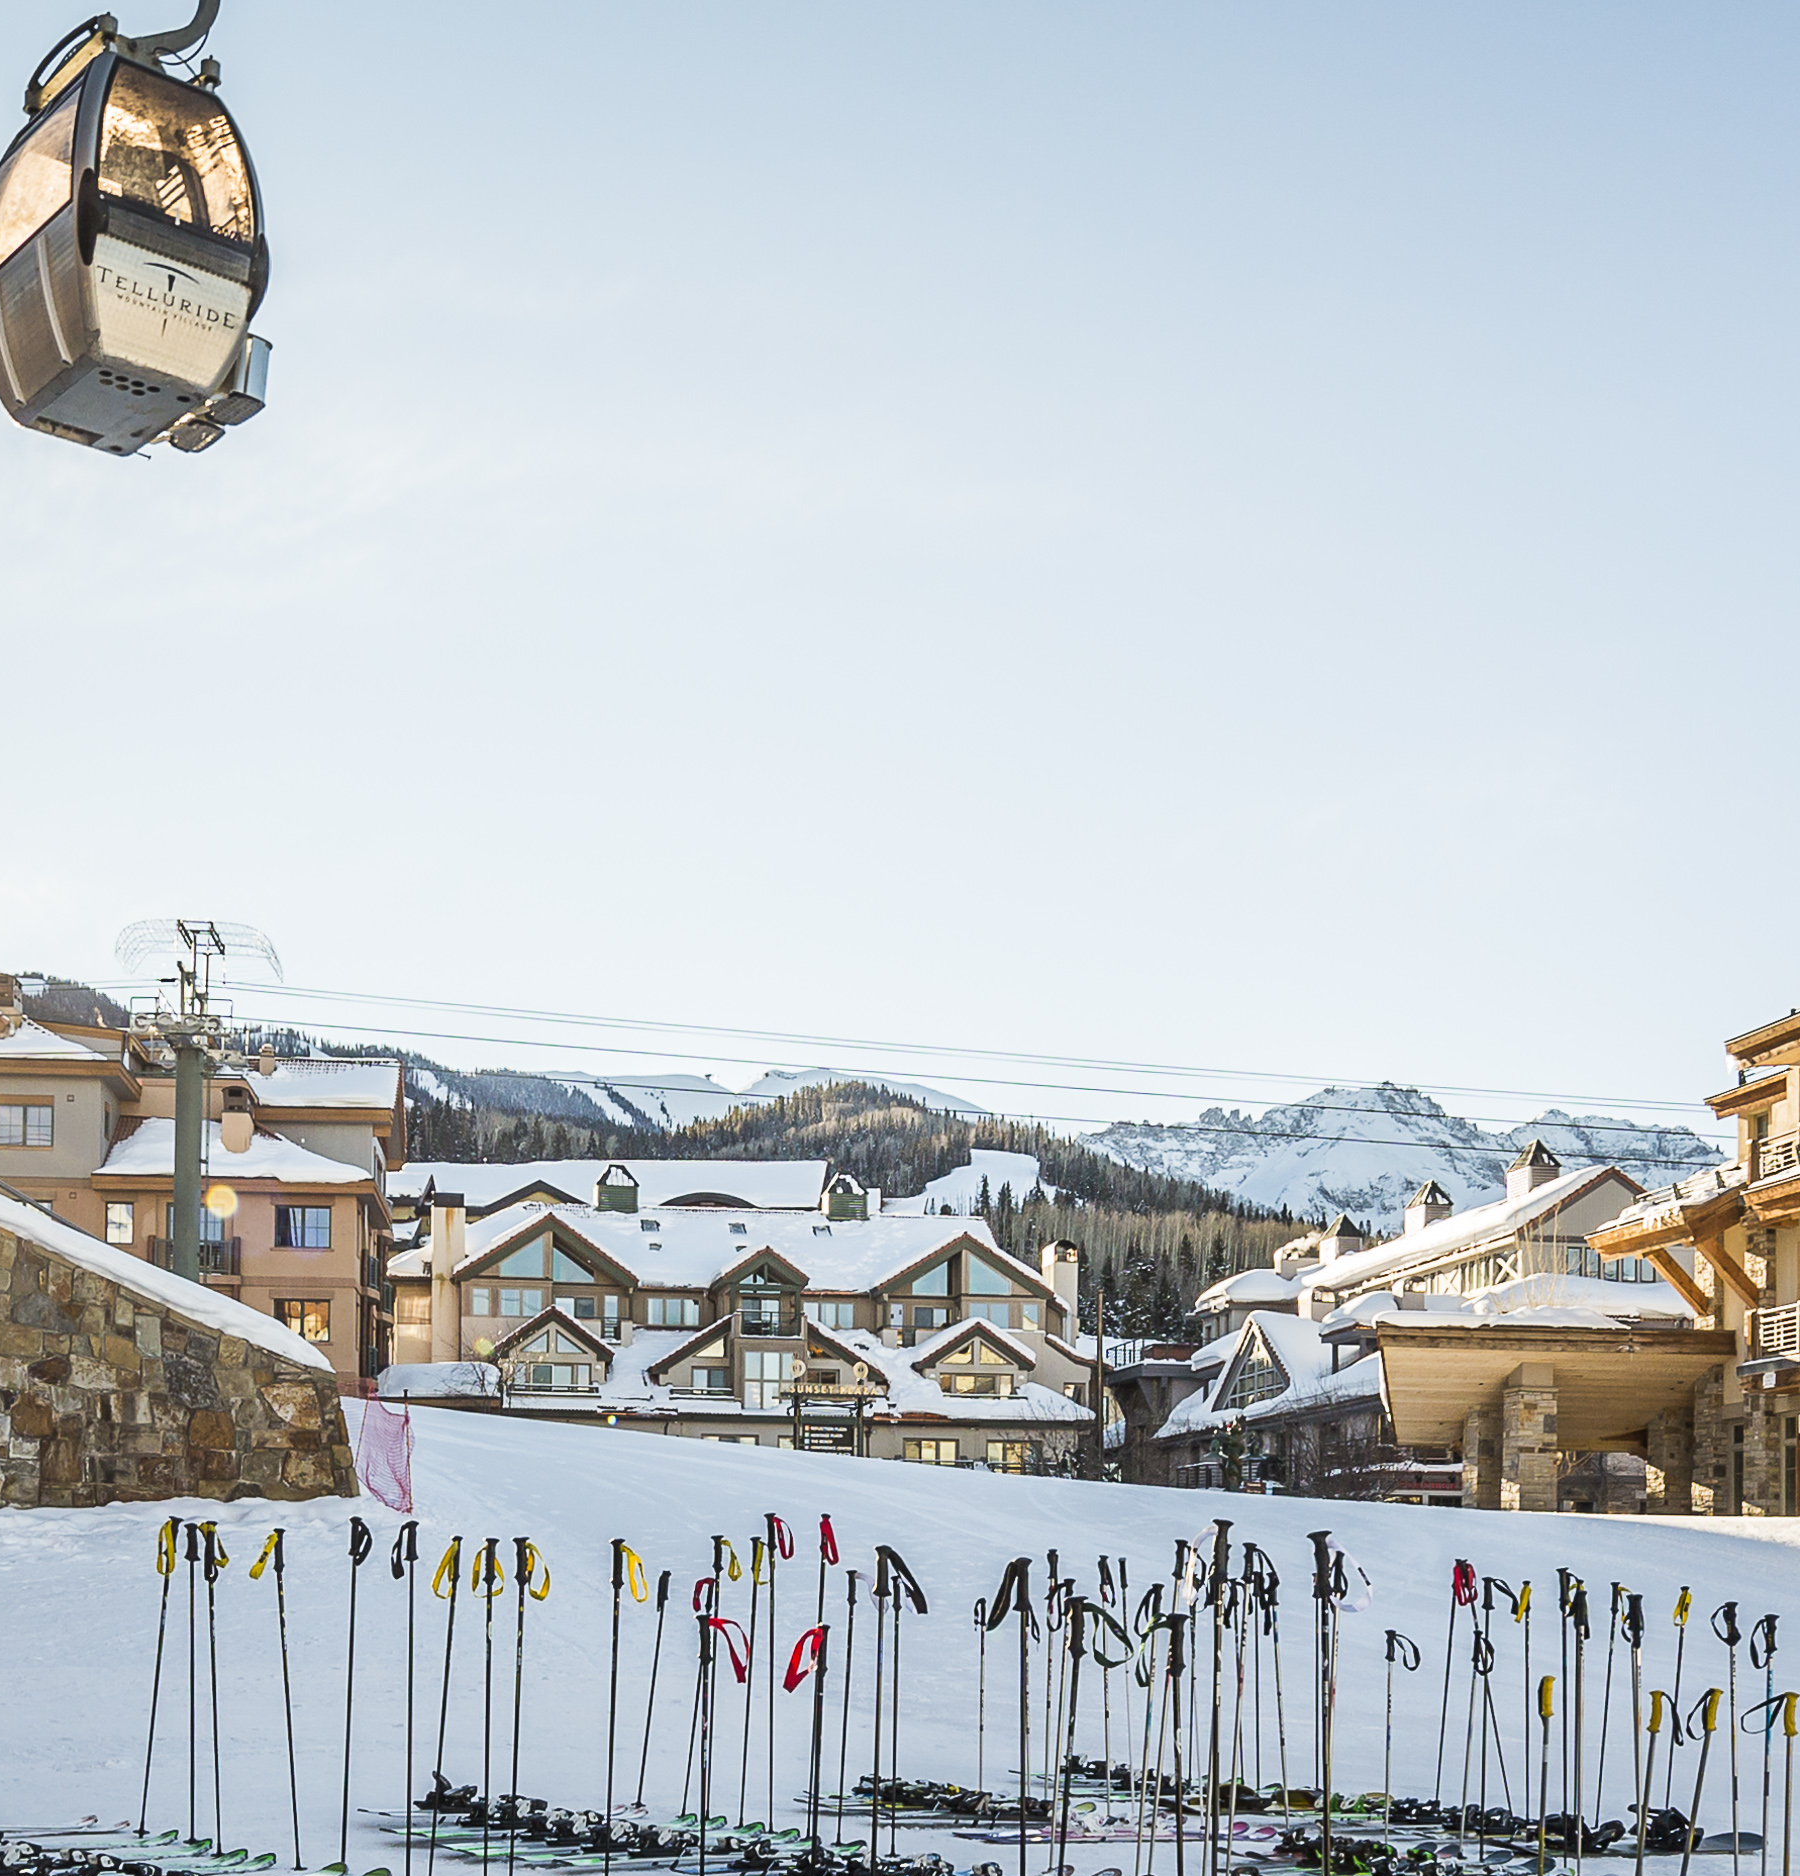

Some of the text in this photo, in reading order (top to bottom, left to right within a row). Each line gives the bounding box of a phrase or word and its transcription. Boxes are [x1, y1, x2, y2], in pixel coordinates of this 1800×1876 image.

[96, 265, 236, 329] TELLURIDE
[790, 1385, 878, 1395] SUNSET PLAZA
